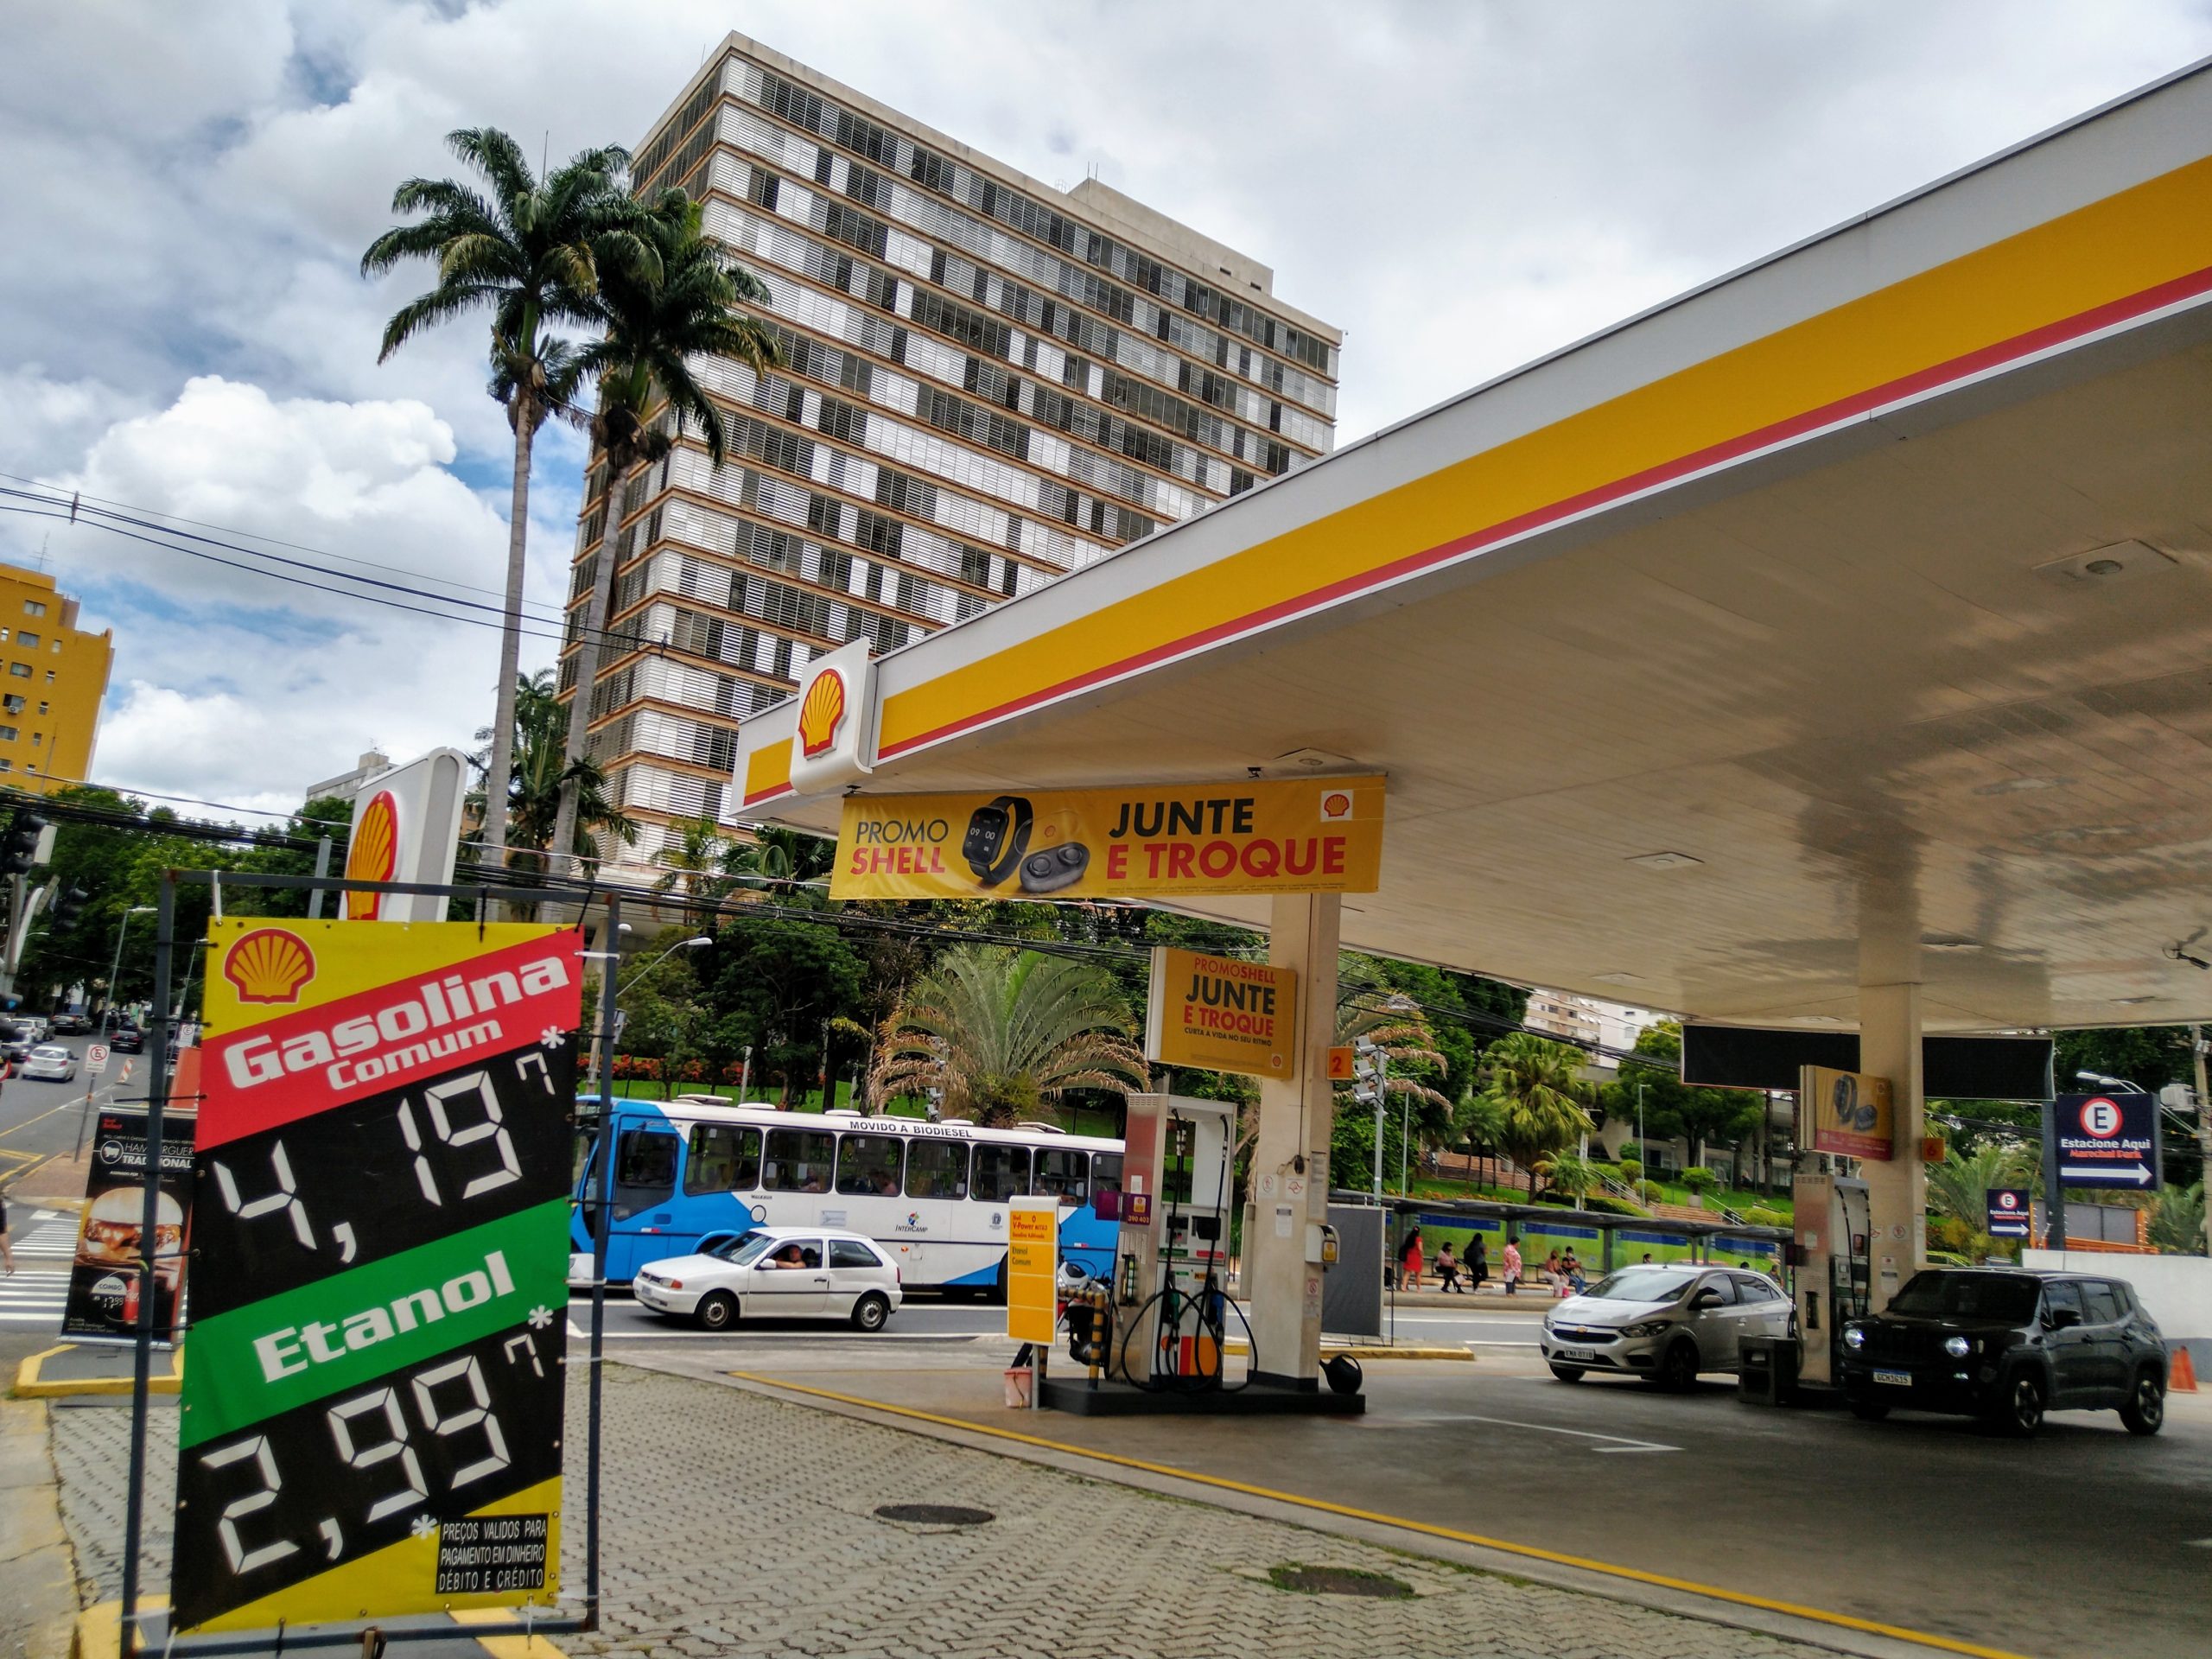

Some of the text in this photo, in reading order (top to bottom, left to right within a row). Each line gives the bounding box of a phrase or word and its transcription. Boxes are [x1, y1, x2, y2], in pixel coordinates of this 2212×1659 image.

[855, 819, 949, 843] PROMO
[1109, 798, 1255, 838] JUNTE
[850, 846, 945, 875] SHELL
[1107, 836, 1346, 880] E TROQUE
[1194, 957, 1275, 984] PROMOSHELL
[1185, 974, 1275, 1015] JUNTE
[224, 956, 570, 1090] Gasolina
[1184, 1005, 1274, 1037] E TROQUE
[1185, 1027, 1205, 1036] CURTA
[1211, 1031, 1227, 1039] VIDA
[1252, 1039, 1272, 1047] RITMO
[327, 1020, 504, 1090] Comum
[1332, 1056, 1342, 1072] 2
[849, 1121, 897, 1132] MOVIDO
[913, 1127, 973, 1138] BIODIESEL
[2061, 1138, 2152, 1151] Estacione Aqui
[252, 1250, 516, 1382] Etanol
[442, 1519, 547, 1544] PREÇOS VALIDOS PARA
[441, 1544, 545, 1566] PAGAMENTO EM DINHEIRO
[439, 1566, 543, 1592] DÉBITO E CRÉDITO
